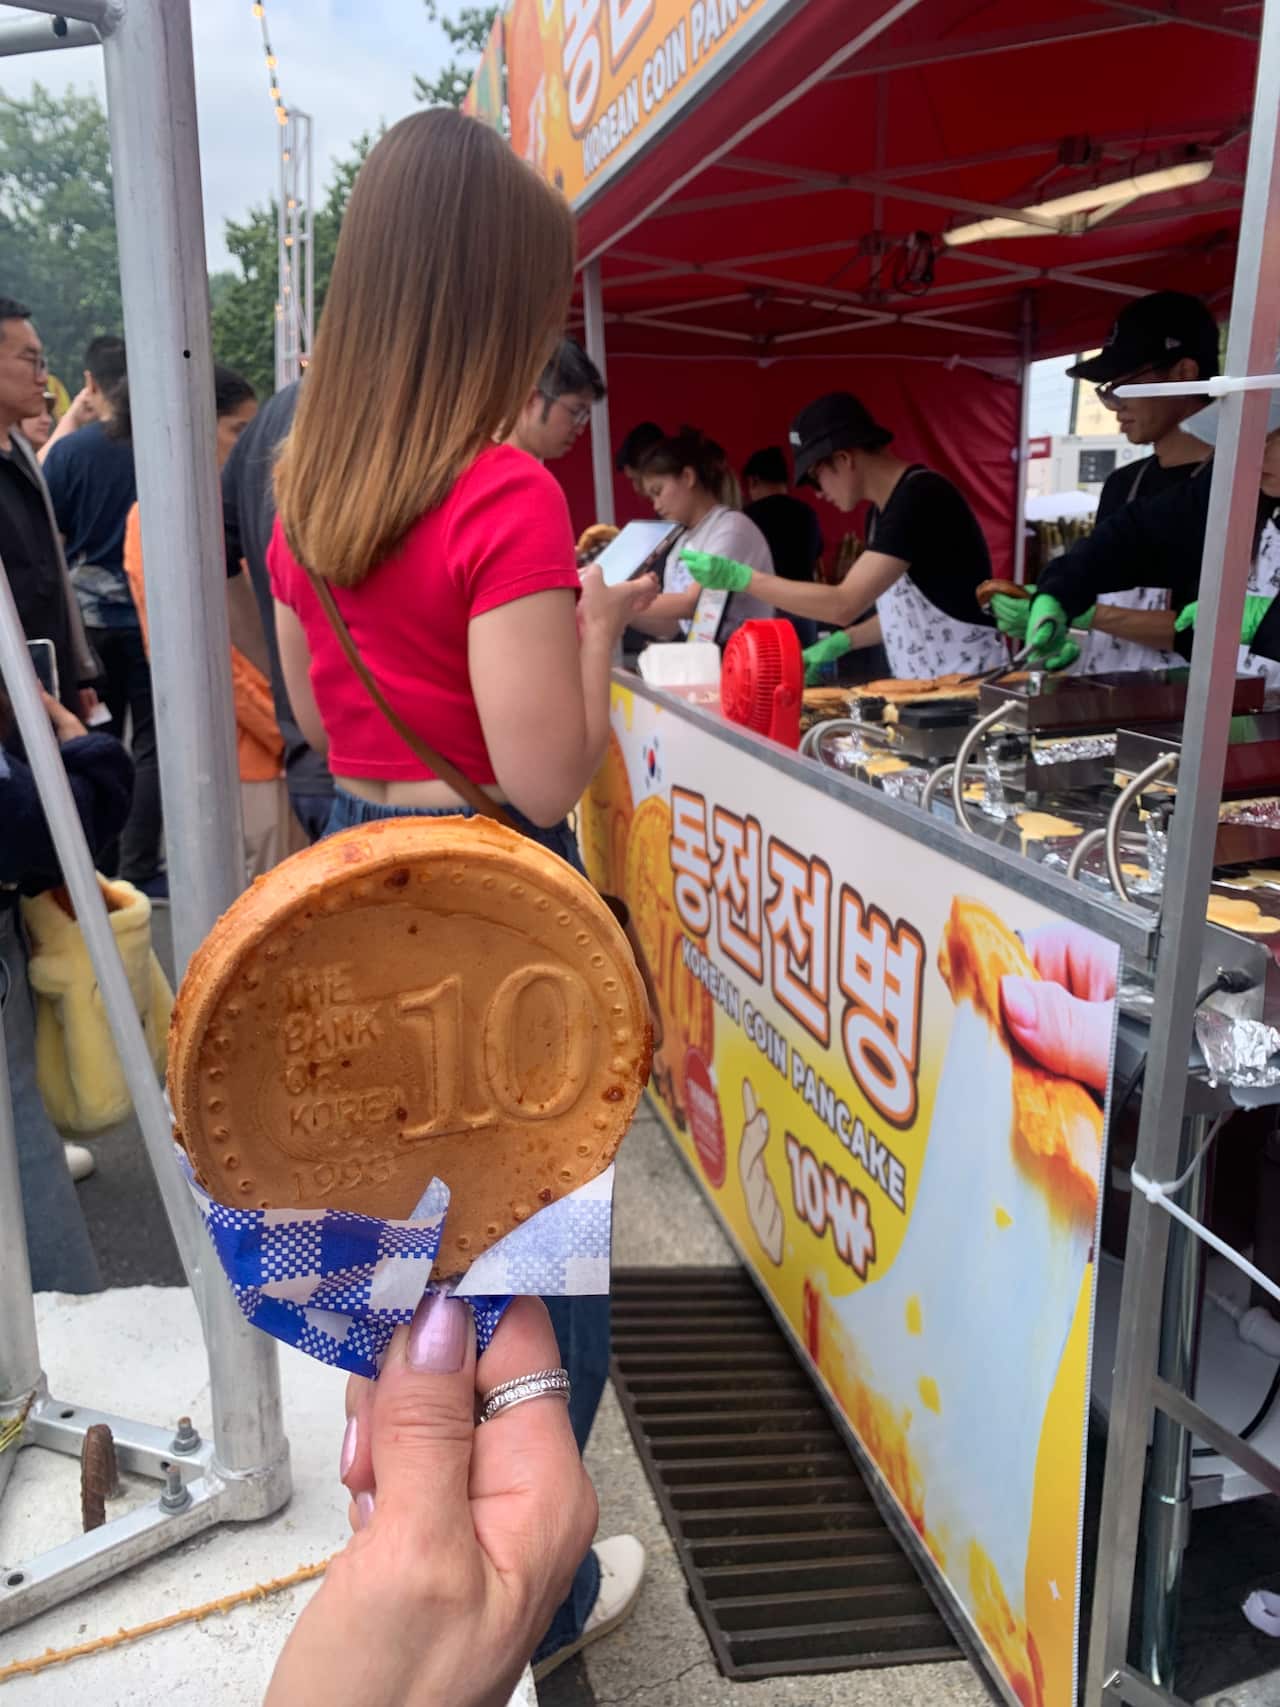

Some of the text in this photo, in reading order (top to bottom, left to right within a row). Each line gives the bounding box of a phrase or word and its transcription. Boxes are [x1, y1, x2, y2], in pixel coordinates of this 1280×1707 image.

[641, 16, 688, 114] COIN
[285, 1004, 380, 1054] BANK
[670, 784, 926, 1131] 동전전병
[396, 961, 598, 1142] 10
[681, 936, 741, 1025] KOREAN
[742, 1000, 788, 1080] COIN
[791, 1047, 906, 1215] PANCAKE
